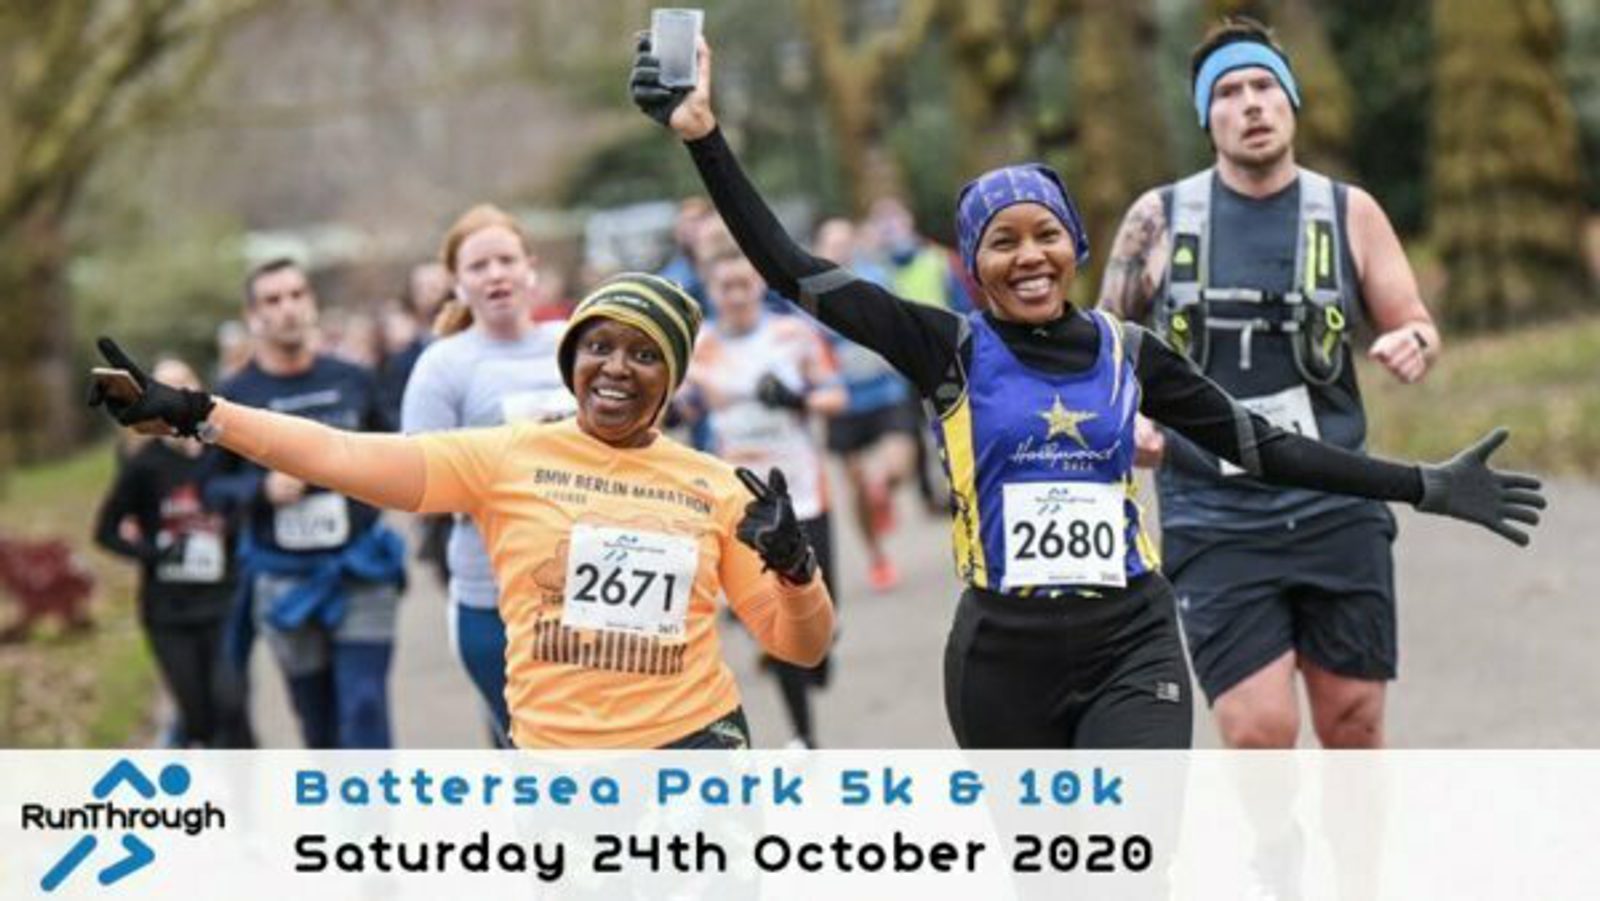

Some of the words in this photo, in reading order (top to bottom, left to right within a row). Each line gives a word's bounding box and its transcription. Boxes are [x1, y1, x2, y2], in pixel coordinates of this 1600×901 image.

[534, 468, 571, 486] BMW
[574, 473, 629, 496] BERLIN
[632, 485, 712, 514] MARATHON
[1012, 519, 1114, 560] 2680
[573, 562, 677, 612] 2671
